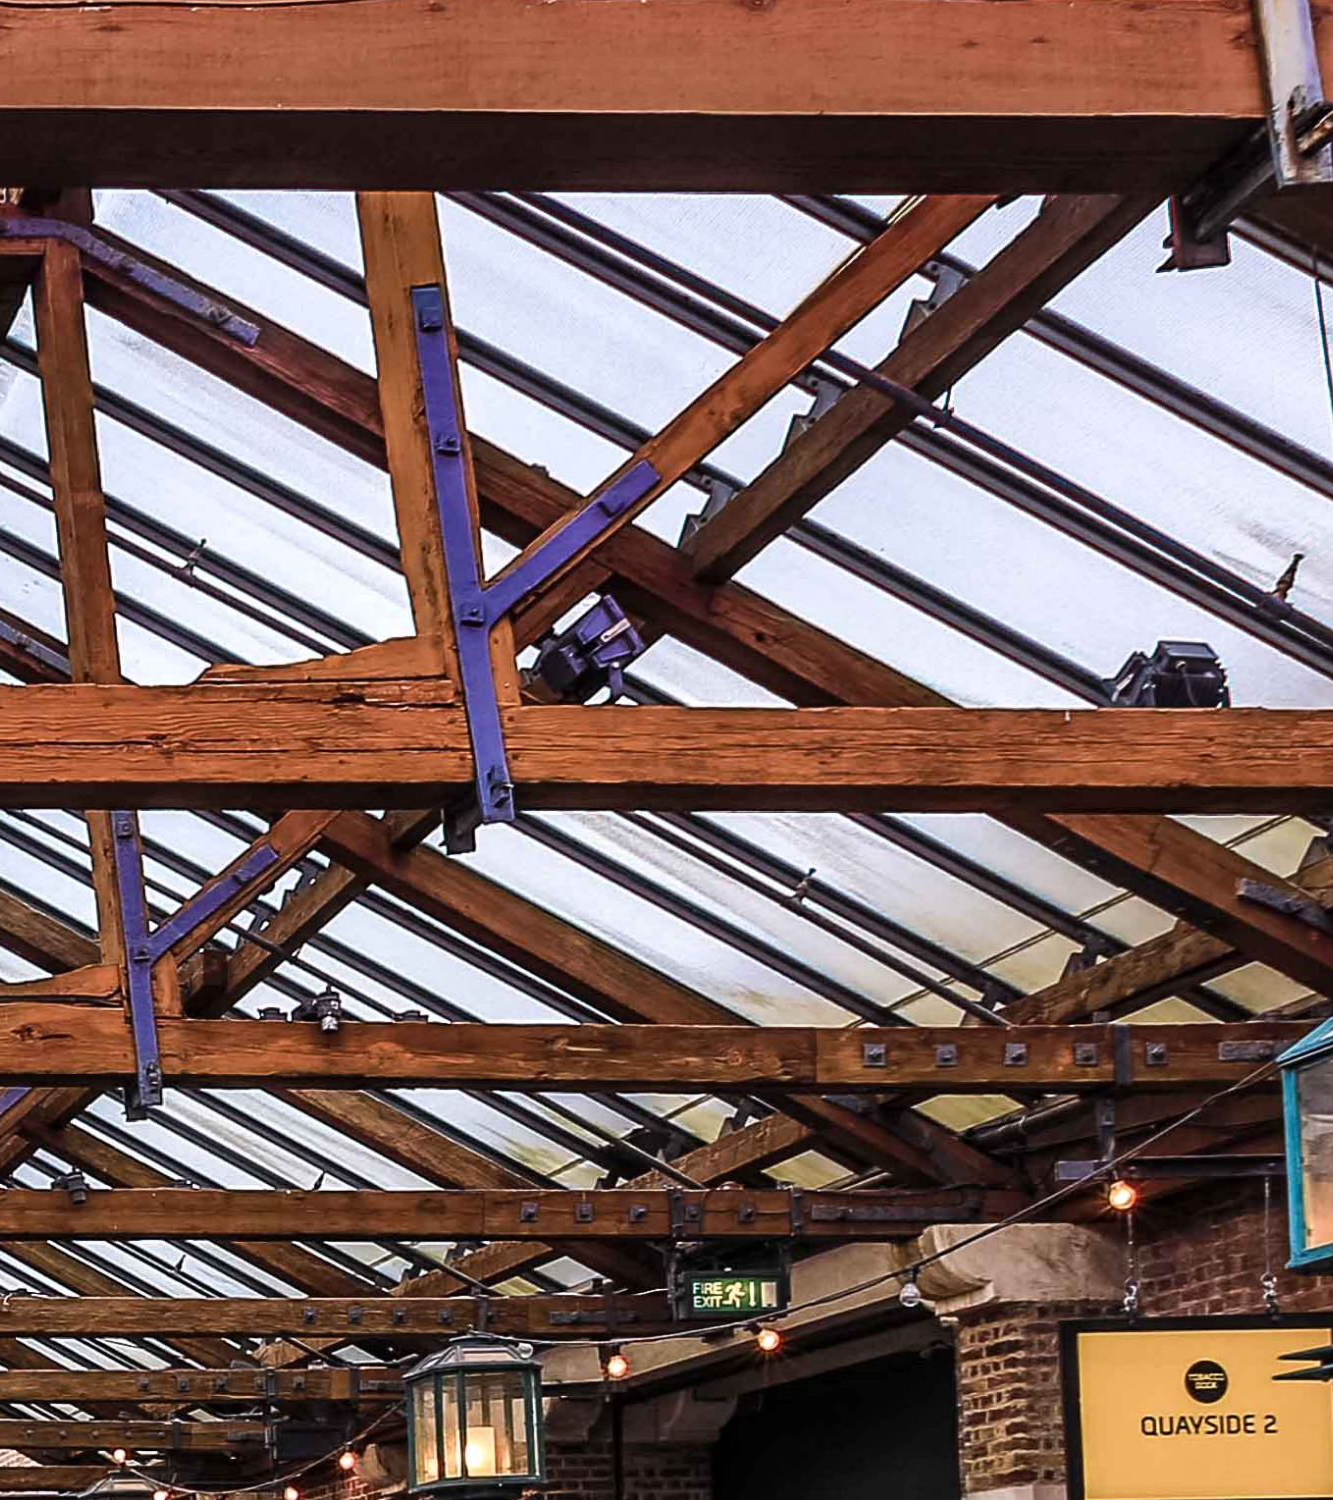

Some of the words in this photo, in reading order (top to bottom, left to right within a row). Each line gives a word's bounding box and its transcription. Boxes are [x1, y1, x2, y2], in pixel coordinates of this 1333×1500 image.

[693, 1281, 723, 1295] FIRE
[693, 1295, 723, 1309] EXIT
[1140, 1414, 1256, 1436] QUAYSIDE
[1263, 1414, 1278, 1434] 2
